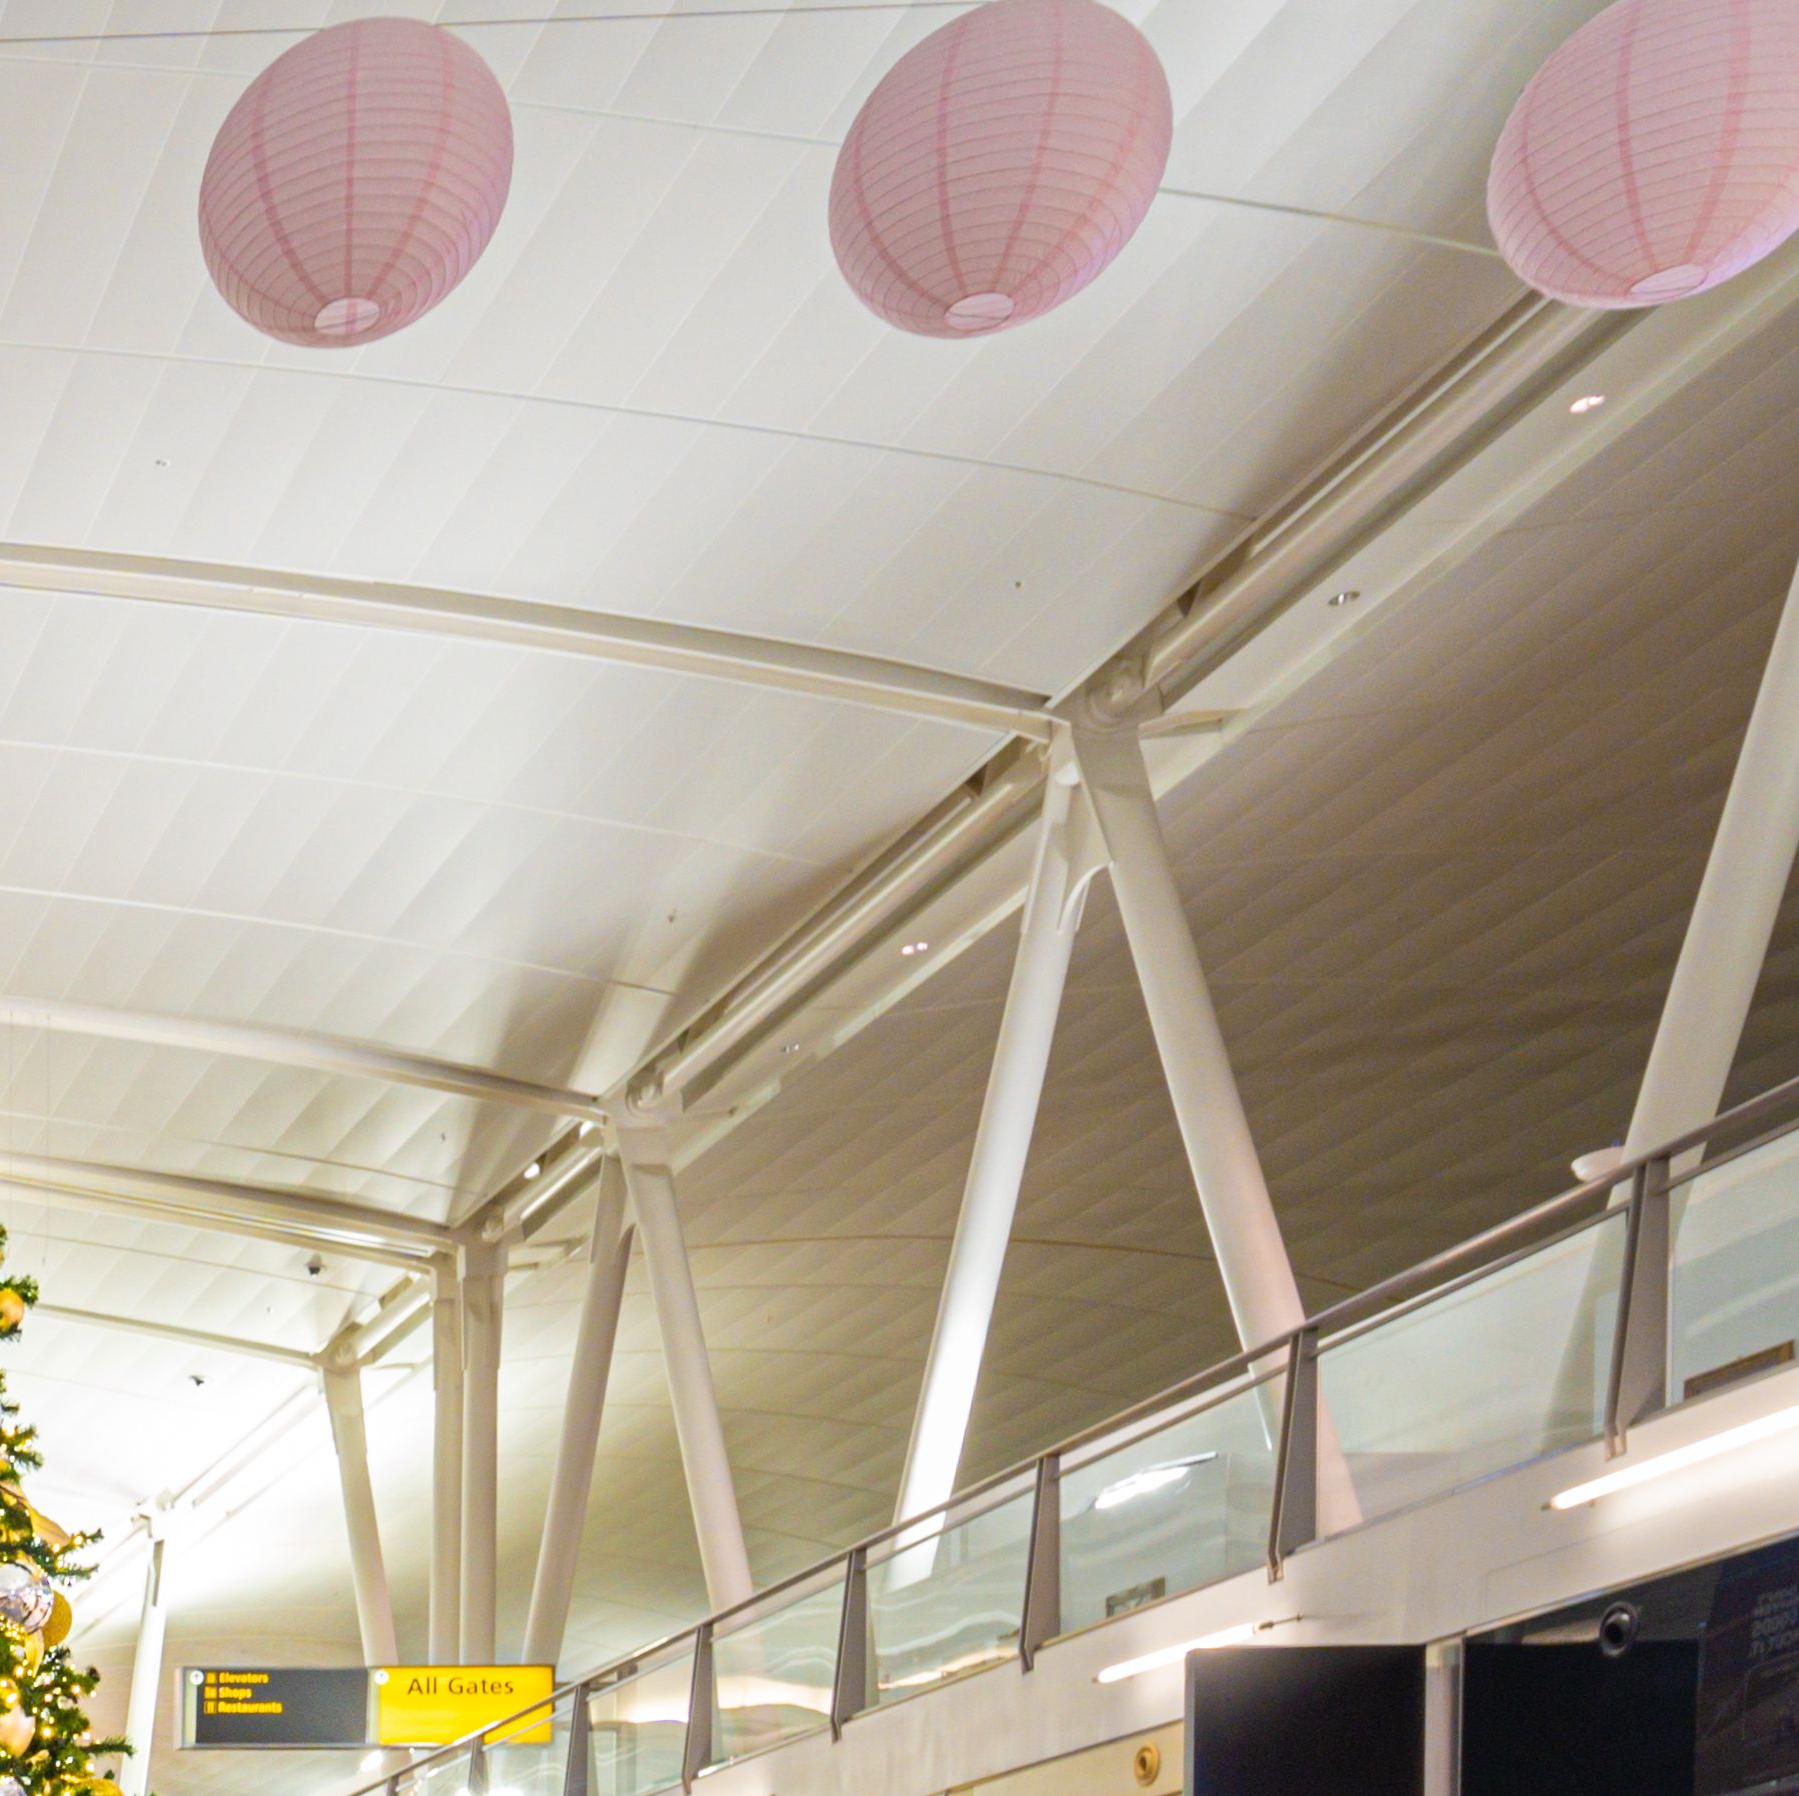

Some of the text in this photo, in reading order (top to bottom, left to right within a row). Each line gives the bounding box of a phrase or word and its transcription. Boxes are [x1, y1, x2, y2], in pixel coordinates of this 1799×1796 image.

[219, 1671, 269, 1684] Elevators
[407, 1676, 514, 1695] All Gates
[219, 1686, 252, 1700] Shops
[217, 1701, 282, 1713] Restaurants
